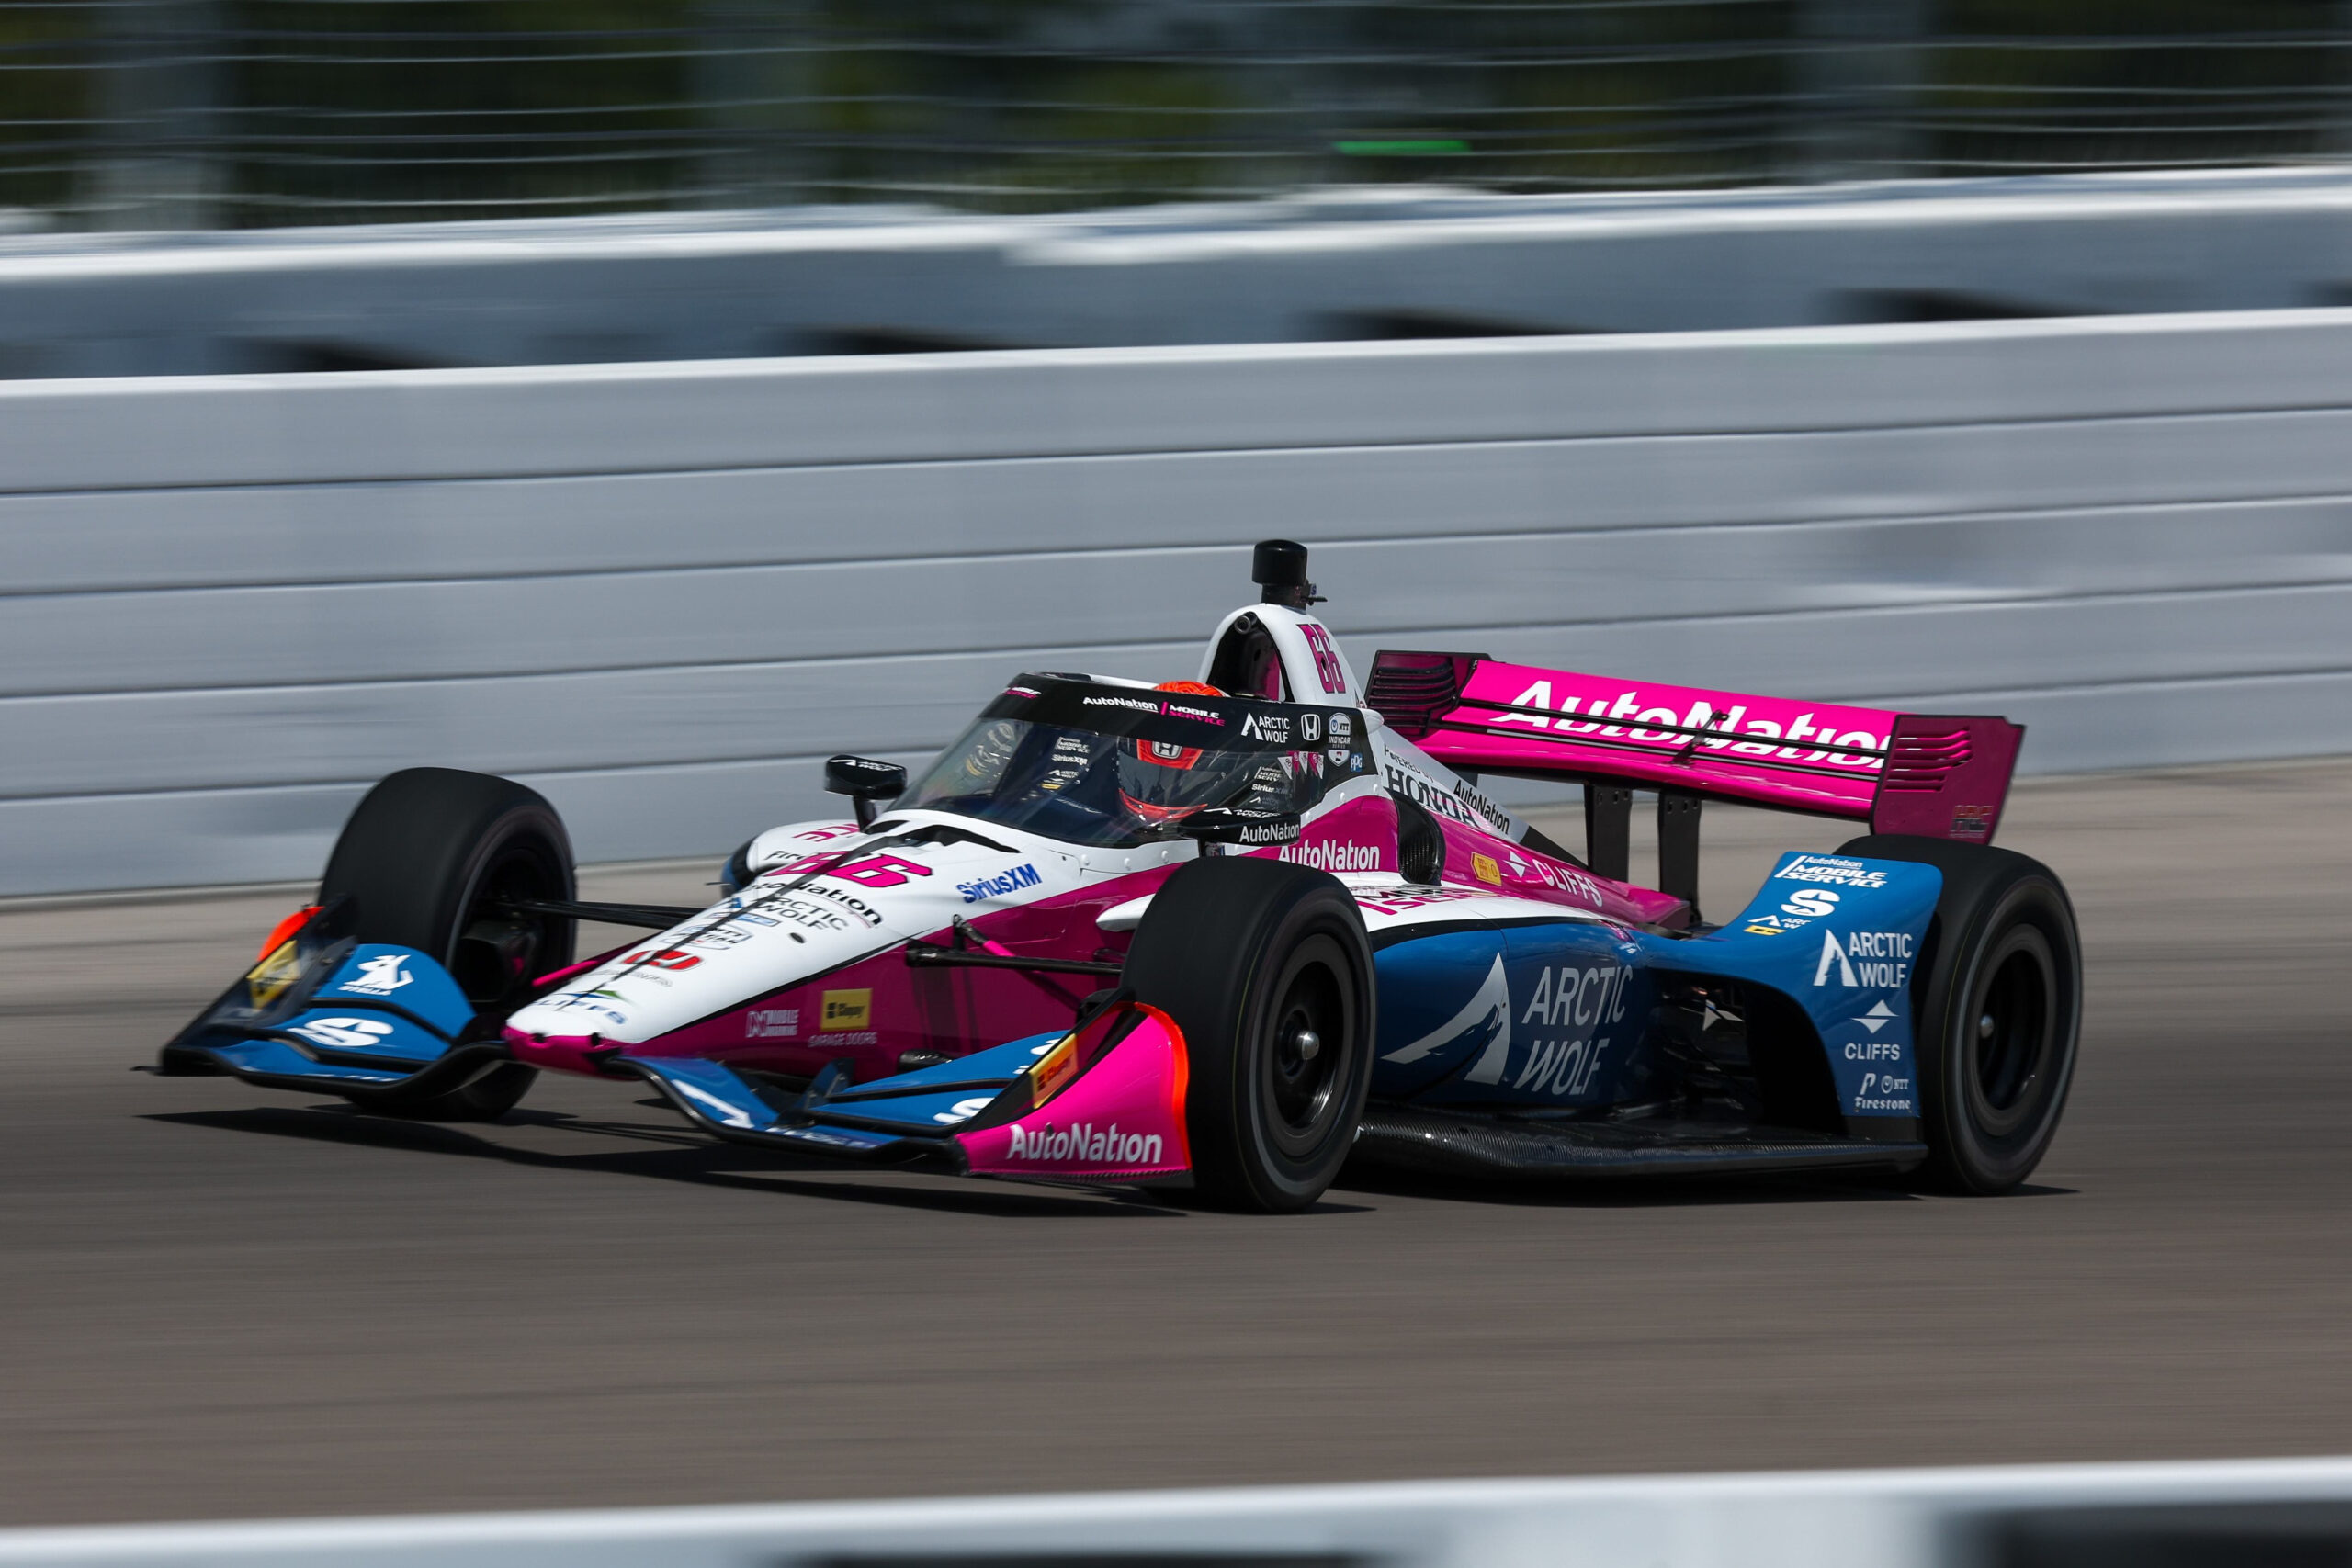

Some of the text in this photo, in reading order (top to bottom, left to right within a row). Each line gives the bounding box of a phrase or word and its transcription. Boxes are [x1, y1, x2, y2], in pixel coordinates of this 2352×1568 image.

[1295, 624, 1346, 694] 66
[1083, 696, 1159, 711] AutoNation
[1169, 705, 1220, 719] MOBILE
[1169, 710, 1226, 727] SERVICE
[1259, 716, 1291, 730] ARCTIC
[1339, 722, 1350, 731] NTT
[1488, 680, 1891, 769] AutoNatio
[1263, 729, 1288, 743] WOLF
[1328, 735, 1351, 745] INDYCAR
[1350, 753, 1363, 771] PPG
[1385, 763, 1484, 830] HONDA
[1453, 779, 1510, 834] AutoNation
[1239, 823, 1300, 843] AutoNation
[1279, 839, 1380, 871] AutoNation
[1804, 856, 1863, 868] AutoNation
[1783, 872, 1888, 888] SERVICE
[1792, 864, 1888, 880] MOBILE
[956, 863, 1043, 904] SiriusXM
[1532, 859, 1603, 908] CLIFFS
[1849, 931, 1913, 959] ARCTIC
[1858, 963, 1907, 988] WOLF
[1522, 964, 1634, 1027] ARCTIC
[1844, 1043, 1901, 1061] CLIFFS
[1513, 1037, 1609, 1097] WOLF
[1894, 1078, 1910, 1089] NTT
[1855, 1097, 1912, 1110] Firestone
[1007, 1122, 1163, 1164] AutoNation
